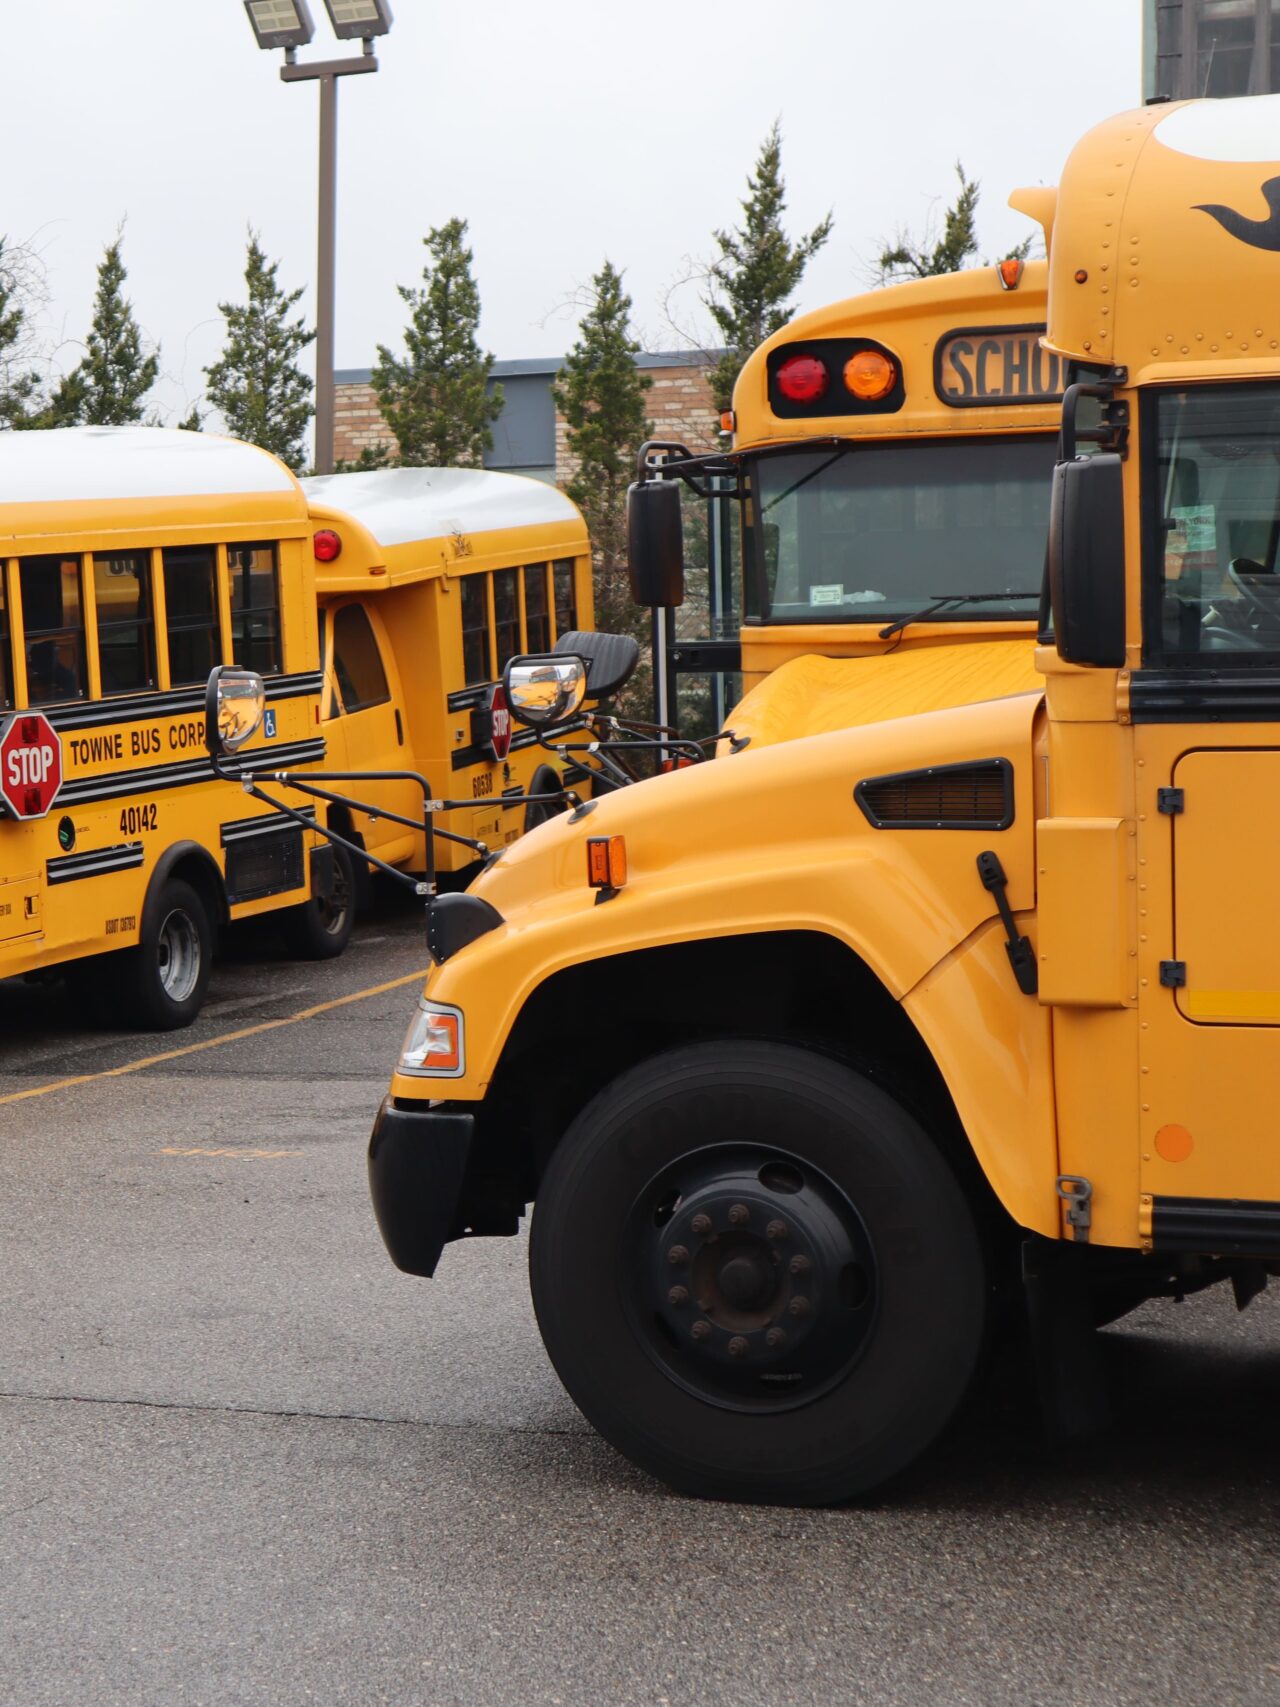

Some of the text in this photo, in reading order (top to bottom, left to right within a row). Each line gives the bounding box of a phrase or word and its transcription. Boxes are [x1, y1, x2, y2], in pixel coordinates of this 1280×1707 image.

[493, 709, 509, 736] STOP
[70, 721, 207, 765] TOWNE BUS CORP.
[8, 745, 54, 786] STOP
[120, 803, 158, 835] 40142
